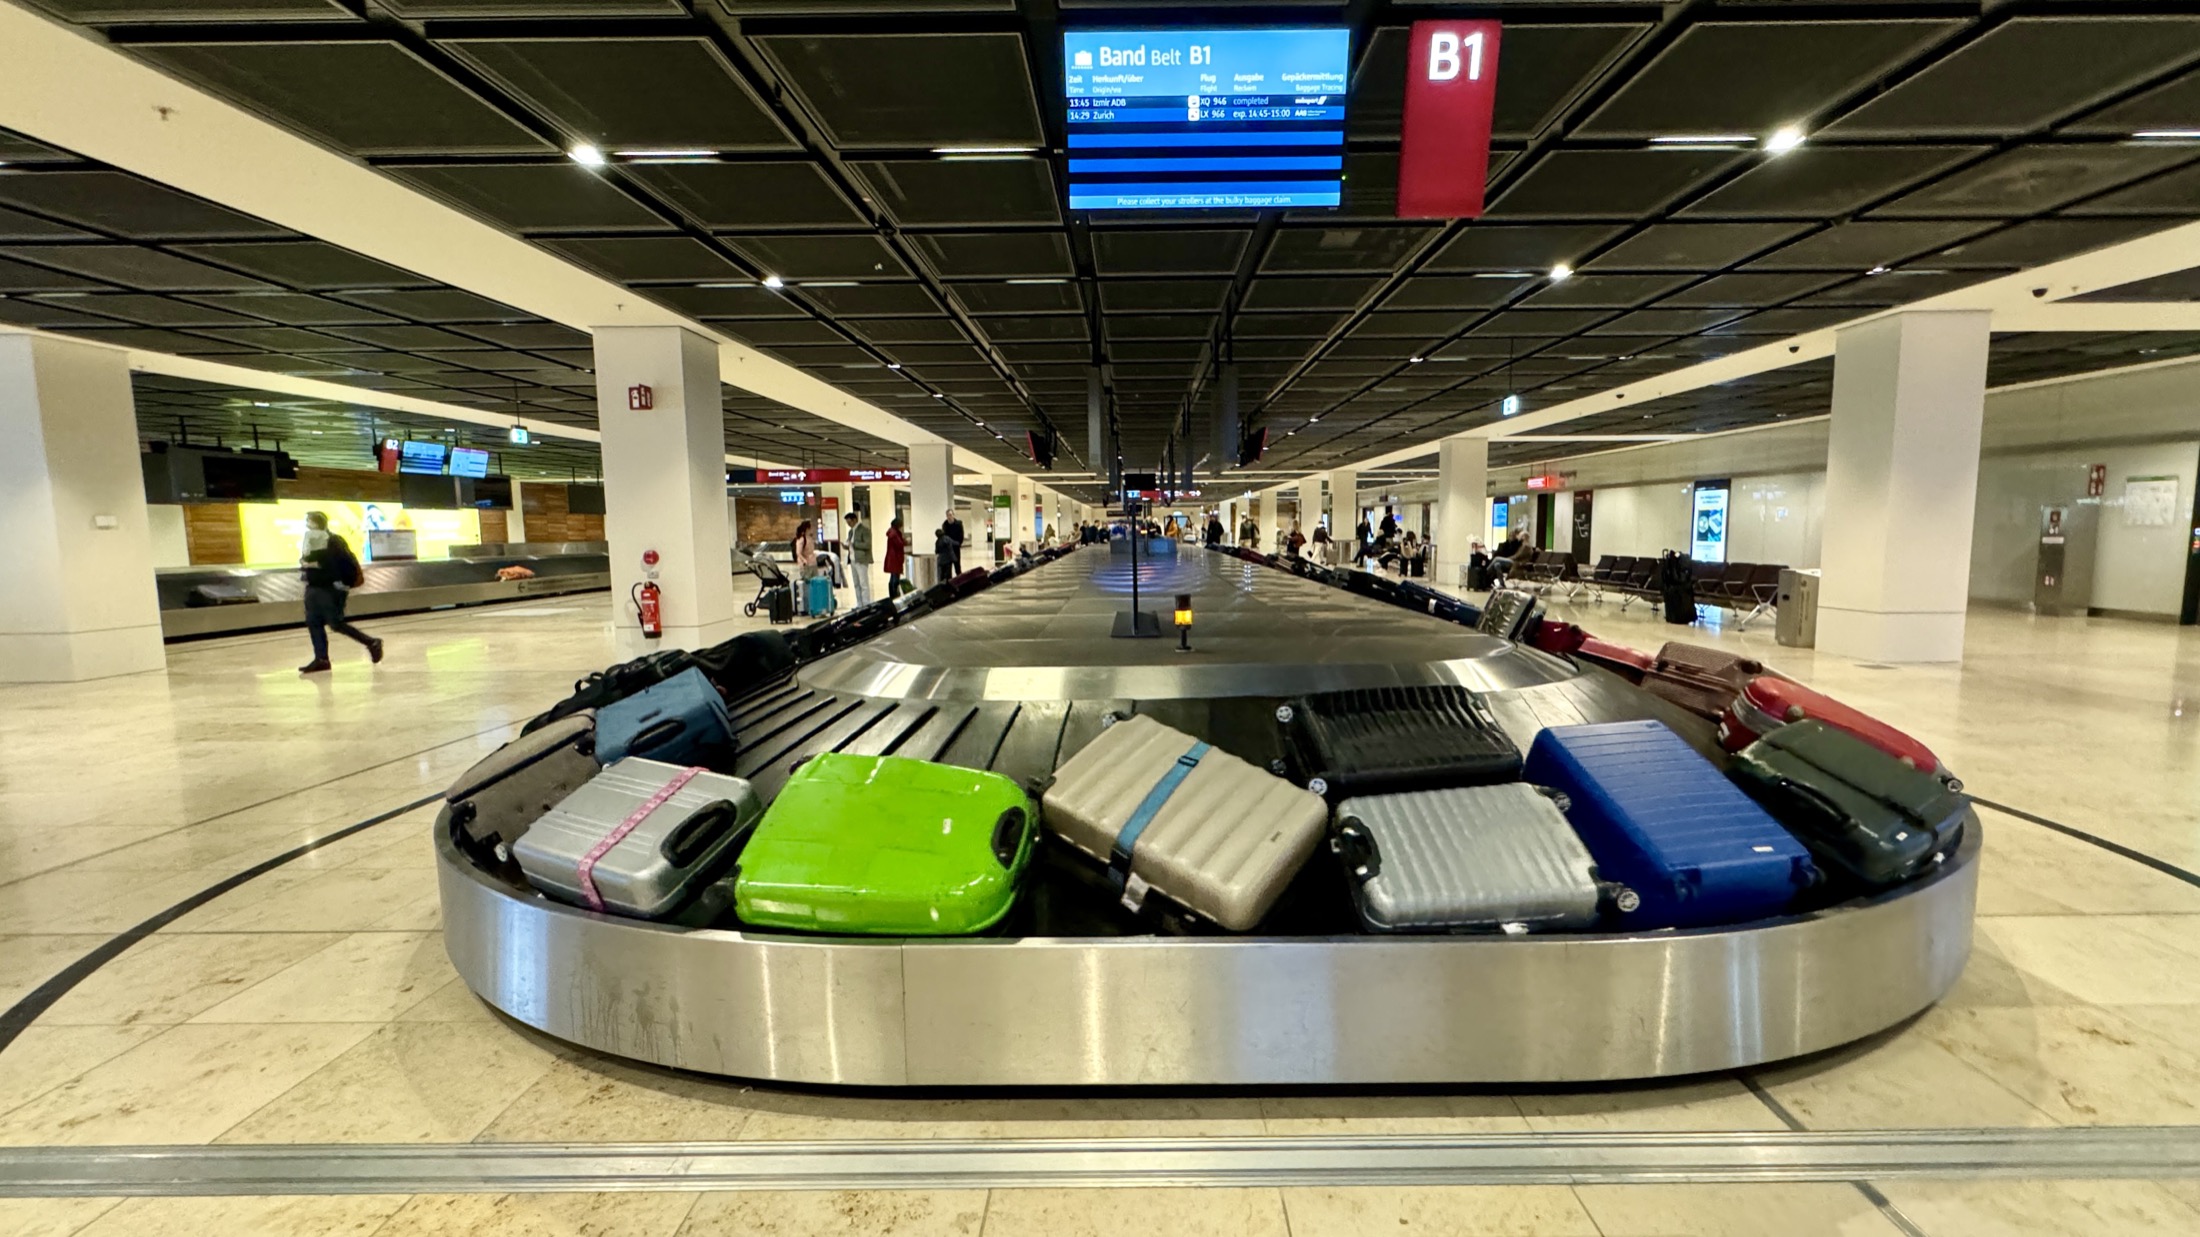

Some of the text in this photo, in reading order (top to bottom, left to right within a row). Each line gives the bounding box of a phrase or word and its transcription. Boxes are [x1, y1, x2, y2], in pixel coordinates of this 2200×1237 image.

[1099, 44, 1211, 67] Band Belt B1
[1428, 32, 1483, 81] B1
[1068, 72, 1344, 84] Zeit Herkunft/über Flug Ausgabe Gepäckermittlung
[1069, 86, 1084, 94] Time
[1200, 84, 1218, 94] Flight
[1295, 83, 1321, 93] Baggage
[1322, 83, 1343, 93] Tracing
[1069, 98, 1090, 107] 13:45
[1111, 98, 1126, 107] ADB
[1200, 97, 1210, 107] XQ
[1213, 97, 1227, 106] 946
[1232, 96, 1269, 106] completed
[1070, 111, 1090, 120] 14:29
[1200, 110, 1209, 119] LX
[1211, 109, 1225, 118] 966
[1233, 111, 1246, 120] exp.
[1248, 109, 1291, 118] 14:45-15:00
[1117, 197, 1138, 206] Please
[1139, 197, 1160, 205] collect
[1161, 198, 1176, 206] your
[1177, 196, 1204, 205] strollers
[1213, 196, 1224, 204] the
[1225, 196, 1244, 206] bulky
[1244, 197, 1273, 206] baggage
